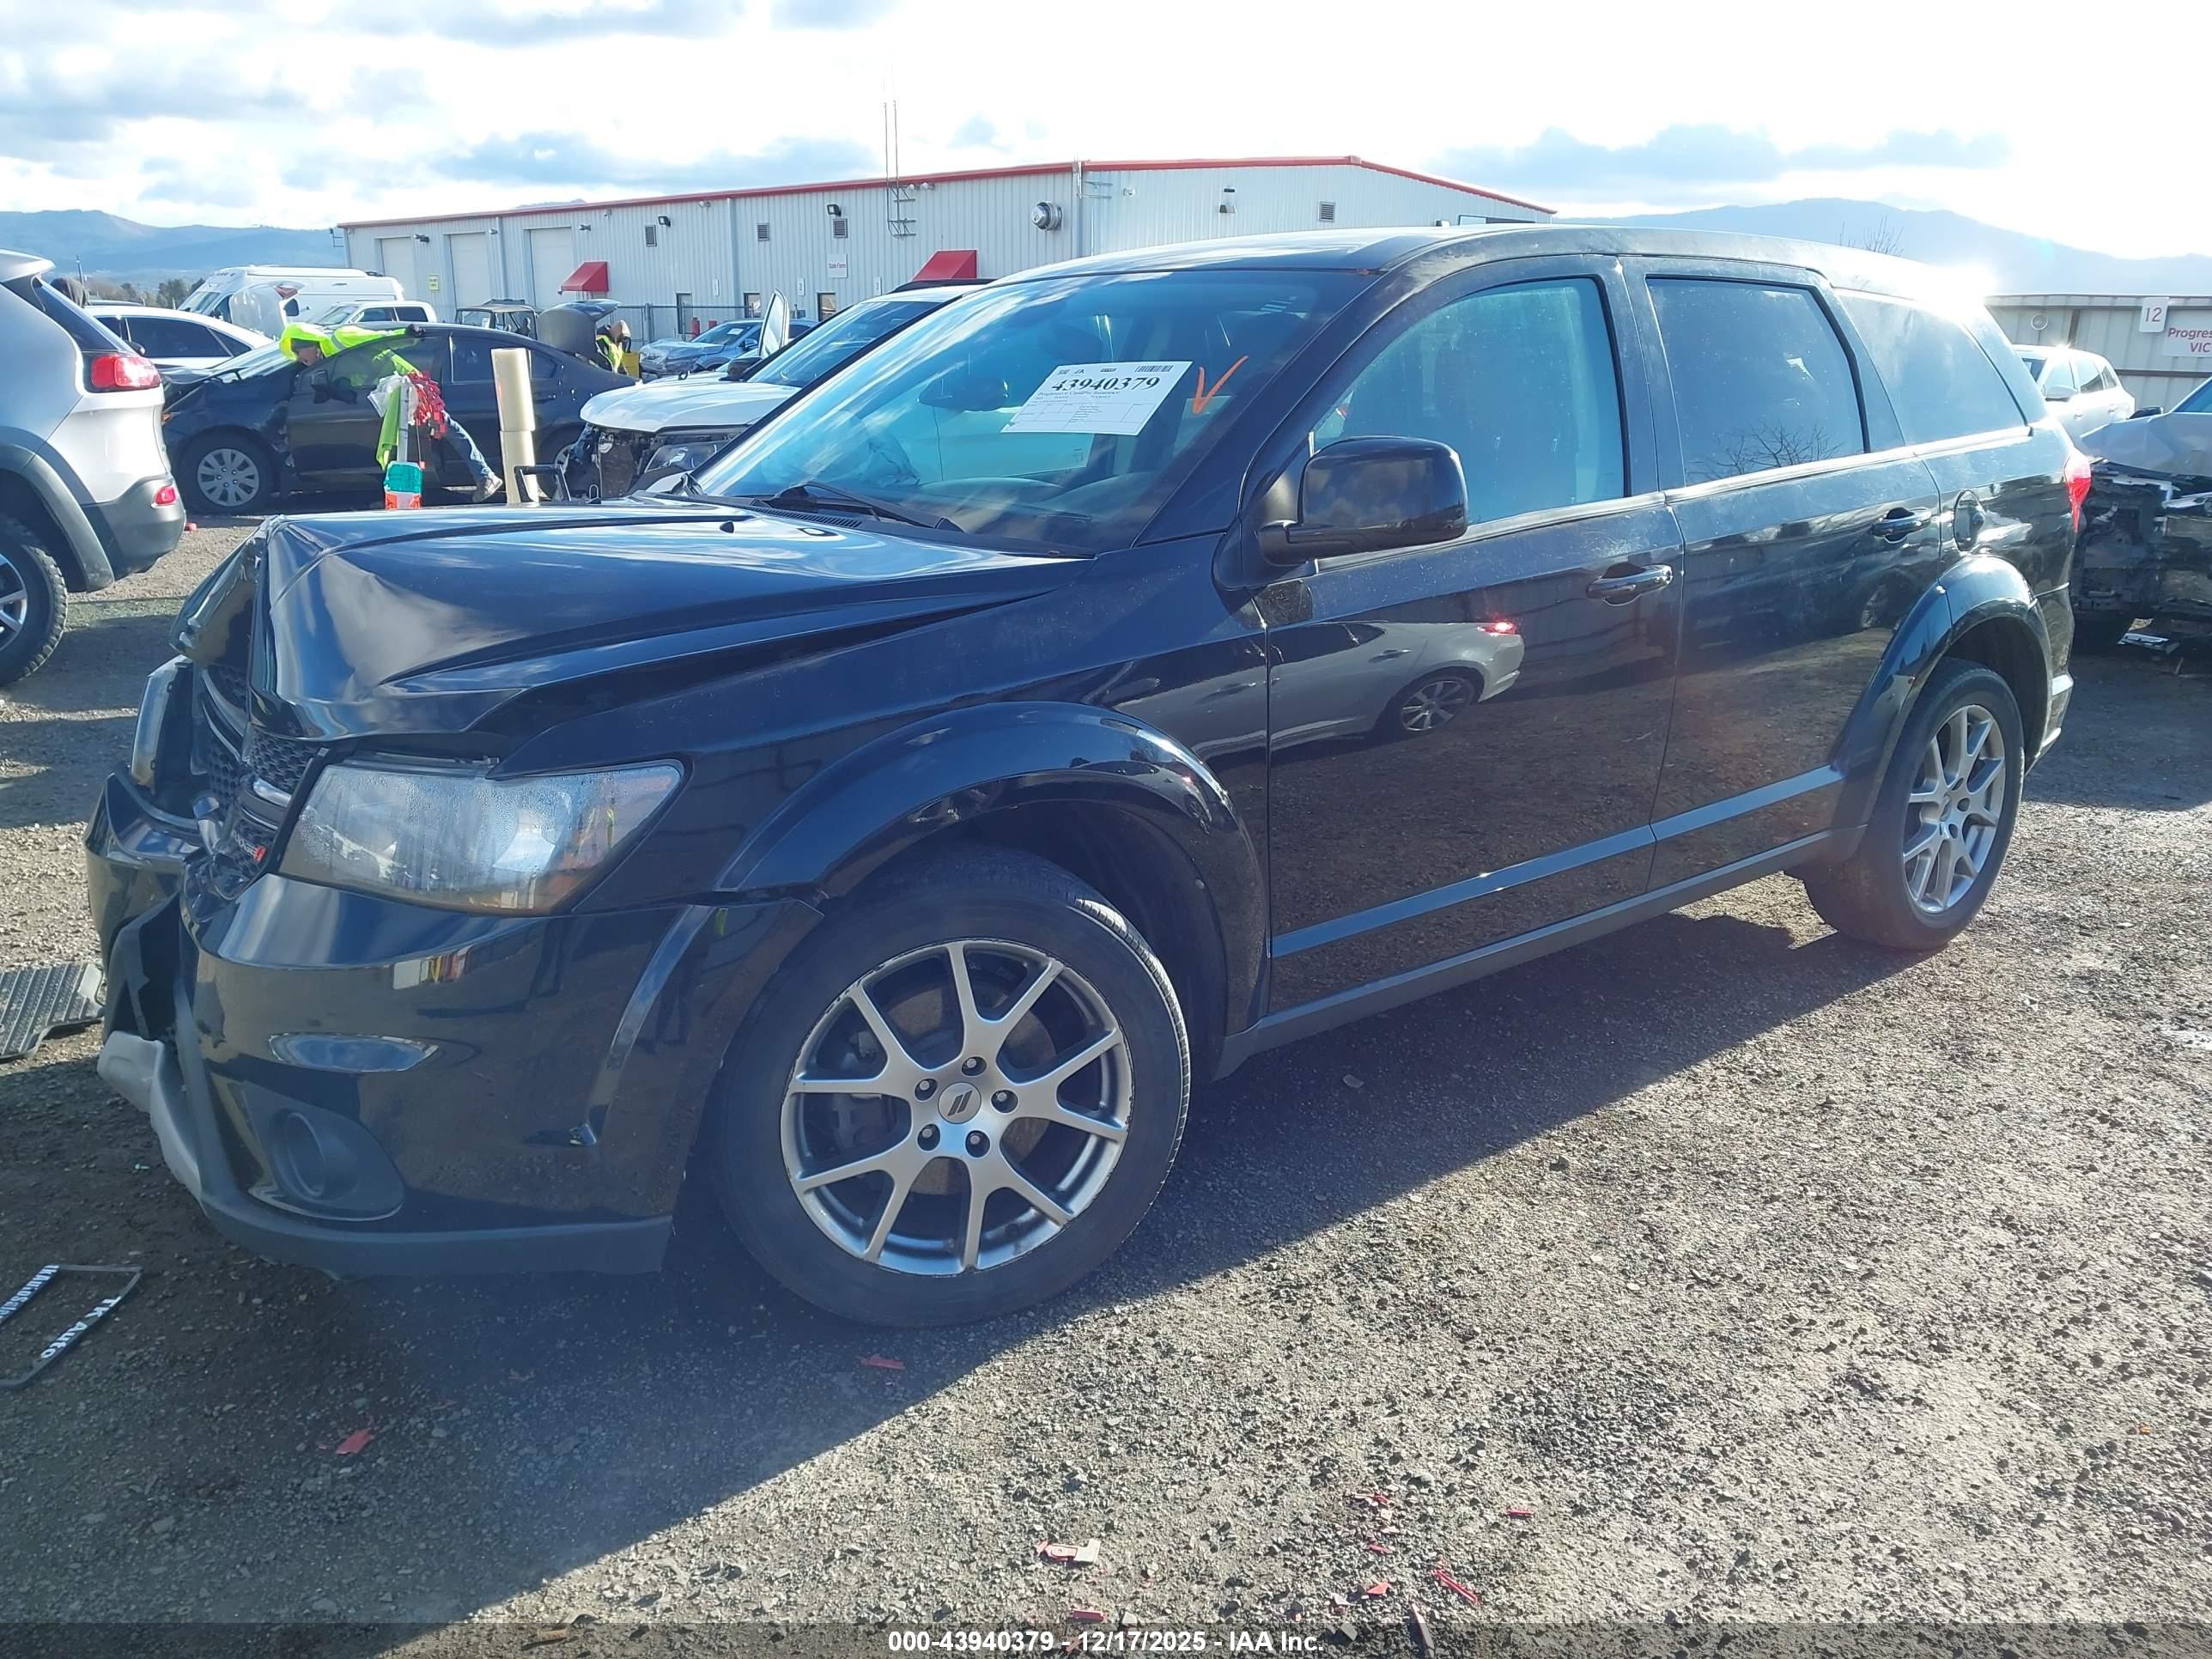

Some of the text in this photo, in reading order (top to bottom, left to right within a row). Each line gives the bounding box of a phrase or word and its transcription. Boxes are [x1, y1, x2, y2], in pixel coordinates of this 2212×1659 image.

[799, 283, 803, 291] 2
[2145, 307, 2162, 322] 12
[2190, 342, 2212, 353] VIC
[1051, 377, 1161, 391] 43940379
[40, 1296, 122, 1359] TK Auto
